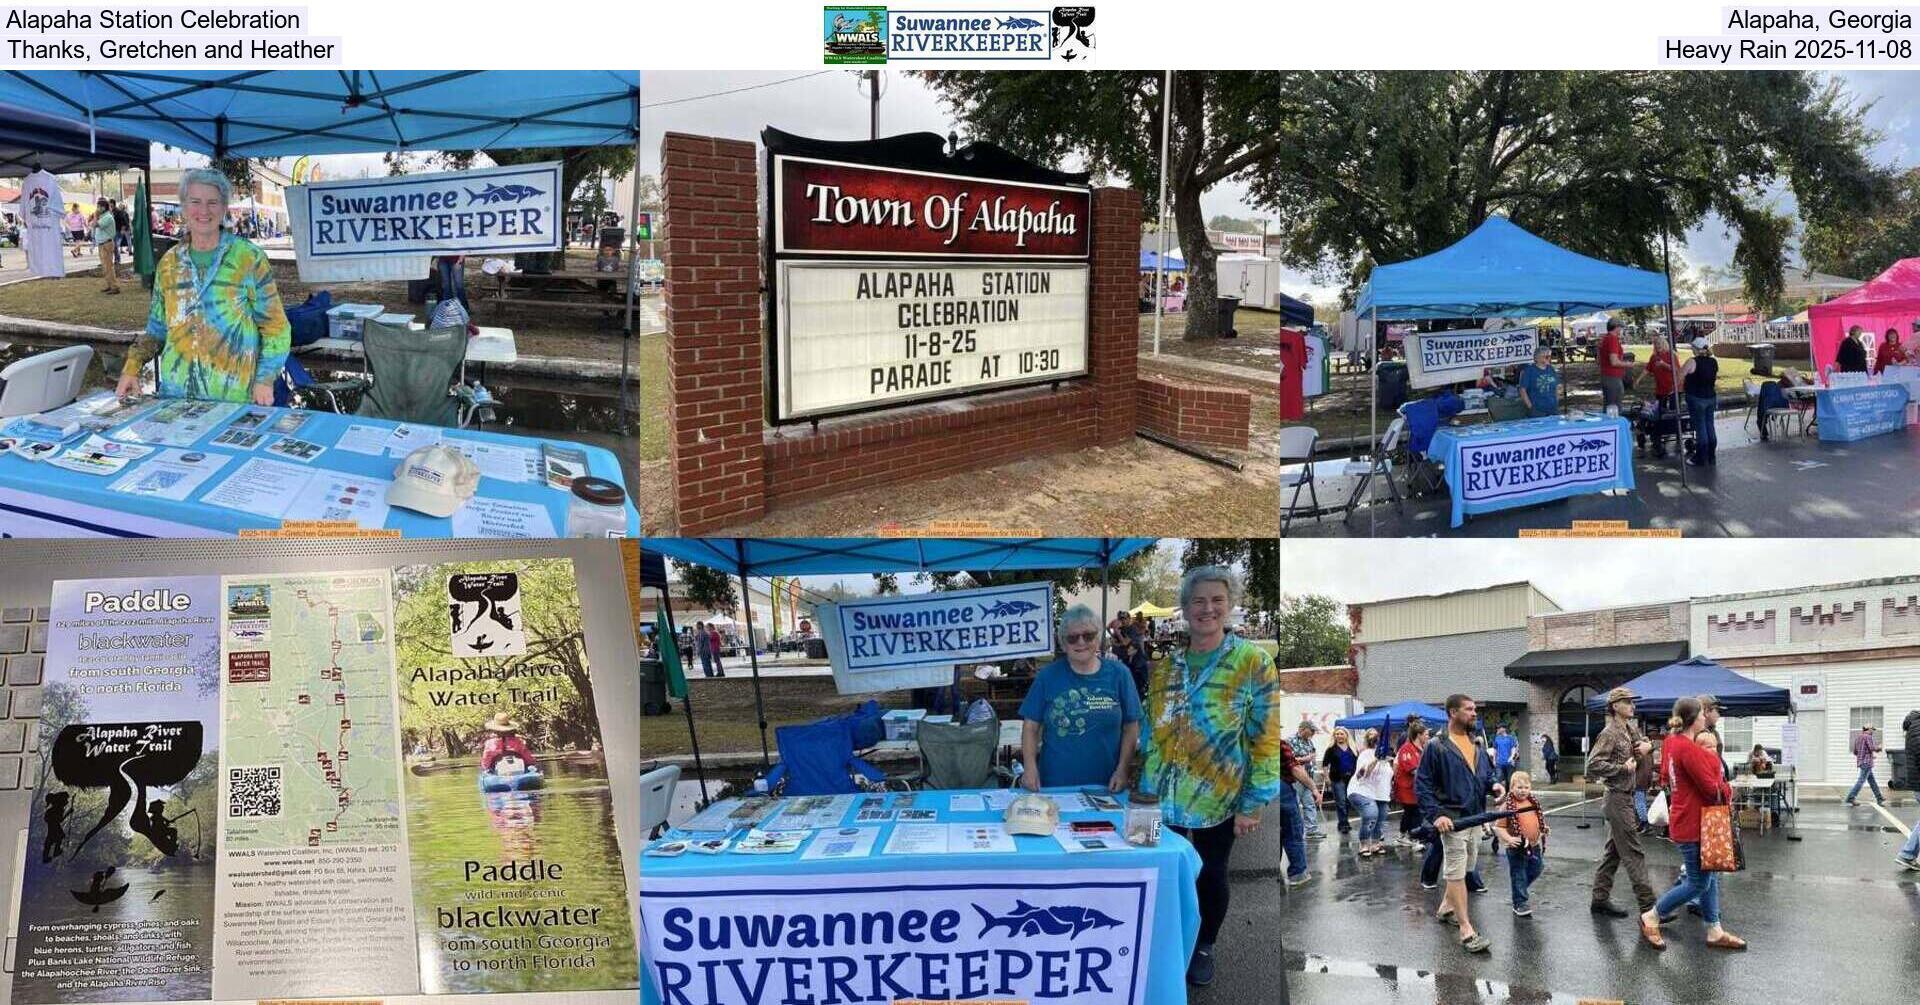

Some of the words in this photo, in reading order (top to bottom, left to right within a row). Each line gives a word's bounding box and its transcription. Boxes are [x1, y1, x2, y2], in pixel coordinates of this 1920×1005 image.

[321, 190, 458, 216] Suwannee
[806, 184, 916, 226] Town
[924, 192, 968, 245] Of
[968, 196, 1077, 247] Alapaha
[856, 272, 954, 299] ALAPAHA
[982, 272, 1050, 296] STATION
[899, 299, 1018, 328] CELEBRATION
[905, 330, 976, 358] 11-8-25
[1426, 337, 1498, 350] Suwannee
[1424, 344, 1532, 366] RIVERKEEPER
[871, 360, 952, 394] PARADE
[980, 355, 1001, 379] AT
[1019, 349, 1059, 374] 10:30
[1471, 442, 1566, 468] Suwannee
[85, 588, 191, 614] Paddle
[854, 606, 974, 631] Suwannee
[79, 632, 193, 650] blackwater
[70, 667, 100, 678] from
[104, 665, 140, 677] south
[143, 664, 194, 678] Georgia
[411, 664, 506, 685] Alapaha
[514, 662, 571, 678] River
[80, 683, 92, 694] to
[96, 682, 131, 693] north
[136, 680, 182, 692] Florida
[429, 690, 500, 707] Water
[507, 687, 559, 703] Trail
[76, 726, 137, 742] Alapaha
[142, 725, 182, 741] River
[84, 740, 130, 757] Water
[136, 739, 172, 756] Trail
[464, 859, 563, 882] Paddle
[464, 890, 493, 900] wild
[29, 924, 50, 932] From
[51, 922, 102, 932] overhanging
[163, 919, 179, 927] and
[436, 905, 602, 929] blackwater
[123, 932, 140, 940] and
[165, 930, 182, 938] with
[663, 906, 960, 952] Suwannee
[34, 946, 53, 954] blue
[176, 941, 192, 949] fish
[482, 936, 532, 951] south
[538, 934, 610, 952] Georgia
[28, 958, 45, 966] Plus
[47, 957, 72, 965] Banks
[73, 957, 94, 965] Lake
[95, 955, 130, 964] National
[453, 958, 470, 971] to
[477, 956, 527, 970] north
[533, 954, 596, 969] Florida
[37, 968, 96, 978] Alapahoochee
[122, 967, 136, 975] the
[184, 964, 201, 972] Sink
[57, 981, 72, 989] and
[90, 979, 123, 989] Alapaha
